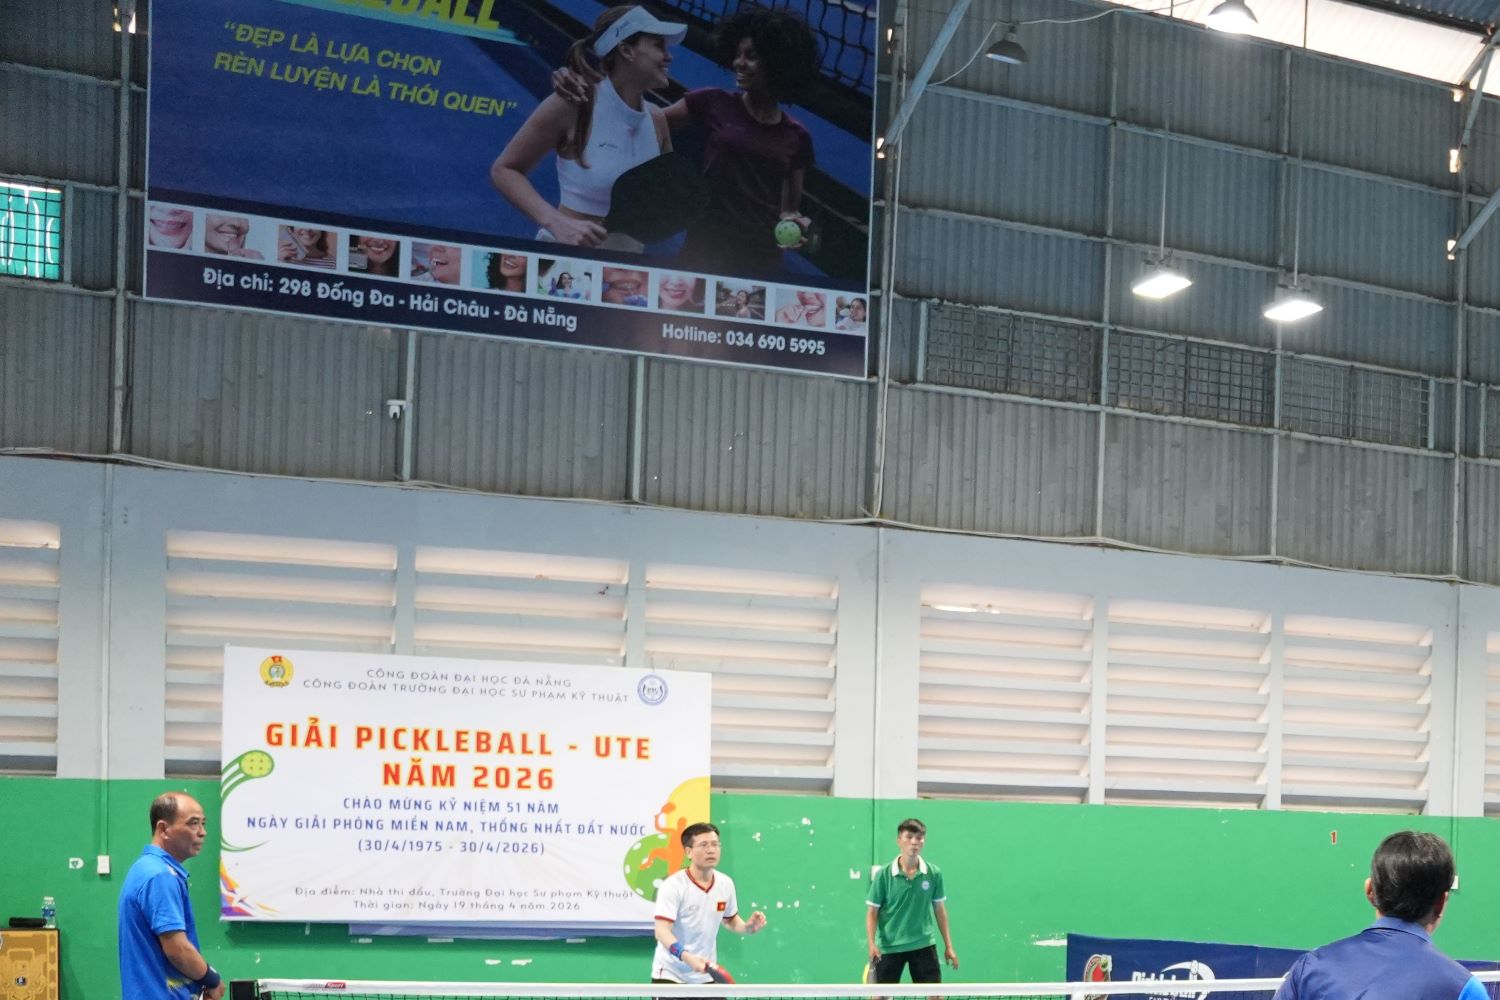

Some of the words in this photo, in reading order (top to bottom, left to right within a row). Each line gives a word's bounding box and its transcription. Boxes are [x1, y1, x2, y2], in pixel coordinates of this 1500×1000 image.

[289, 32, 319, 55] LÀ
[325, 40, 370, 64] LỰA
[377, 50, 441, 76] CHỌN
[213, 51, 265, 77] RÈN
[270, 62, 348, 91] LUYỆN
[352, 75, 381, 97] LÀ
[203, 267, 234, 290] Địa
[240, 275, 273, 292] chỉ:
[279, 278, 311, 297] 298
[317, 280, 364, 308] Đống
[369, 289, 394, 307] Đa
[410, 293, 439, 313] Hải
[443, 298, 490, 319] Châu
[504, 304, 528, 323] Đà
[533, 306, 577, 332] Nẵng
[662, 323, 722, 344] Hotline:
[726, 330, 754, 347] 034
[758, 334, 786, 351] 690
[789, 339, 826, 355] 5995
[303, 678, 342, 689] CÔNG
[348, 681, 386, 691] ĐOÀN
[393, 683, 447, 694] TRƯỜNG
[452, 686, 474, 696] ĐẠI
[480, 688, 505, 698] HỌC
[532, 691, 566, 701] PHẠM
[592, 693, 628, 703] THUẬT
[366, 668, 405, 679] CÔNG
[411, 671, 448, 681] ĐOÀN
[454, 673, 476, 684] ĐẠI
[482, 675, 508, 685] HỌC
[514, 674, 530, 685] ĐÀ
[536, 675, 572, 688] NẴNG
[265, 717, 338, 748] GIẢI
[355, 726, 553, 756] PICKLEBALL
[593, 736, 651, 760] UTE
[382, 758, 457, 788] NĂM
[473, 766, 554, 790] 2026
[343, 796, 382, 810] CHÀO
[389, 797, 432, 811] MỪNG
[439, 797, 457, 811] KỶ
[463, 800, 500, 815] NIỆM
[507, 803, 521, 813] 51
[527, 801, 559, 814] NĂM
[247, 815, 288, 829] NGÀY
[295, 814, 326, 829] GIẢI
[333, 816, 384, 830] PHÓNG
[435, 820, 474, 834] NAM,
[480, 818, 528, 834] THỐNG
[534, 818, 572, 834] NHẤT
[578, 819, 604, 835] ĐẤT
[610, 822, 646, 836] NƯỚC
[358, 839, 443, 852] (30/4/1975
[460, 841, 545, 855] 30/4/2026)
[295, 887, 316, 897] Địa
[321, 884, 355, 896] điểm:
[360, 887, 384, 896] Nhà
[389, 887, 404, 896] thi
[485, 888, 505, 898] Đại
[509, 888, 528, 898] học
[550, 888, 583, 900] phạm
[354, 900, 379, 909] Thời
[383, 900, 414, 911] gian:
[418, 901, 449, 911] Ngày
[454, 901, 465, 910] 19
[470, 901, 505, 912] tháng
[509, 902, 516, 910] 4
[520, 902, 545, 910] năm
[550, 902, 581, 911] 2026
